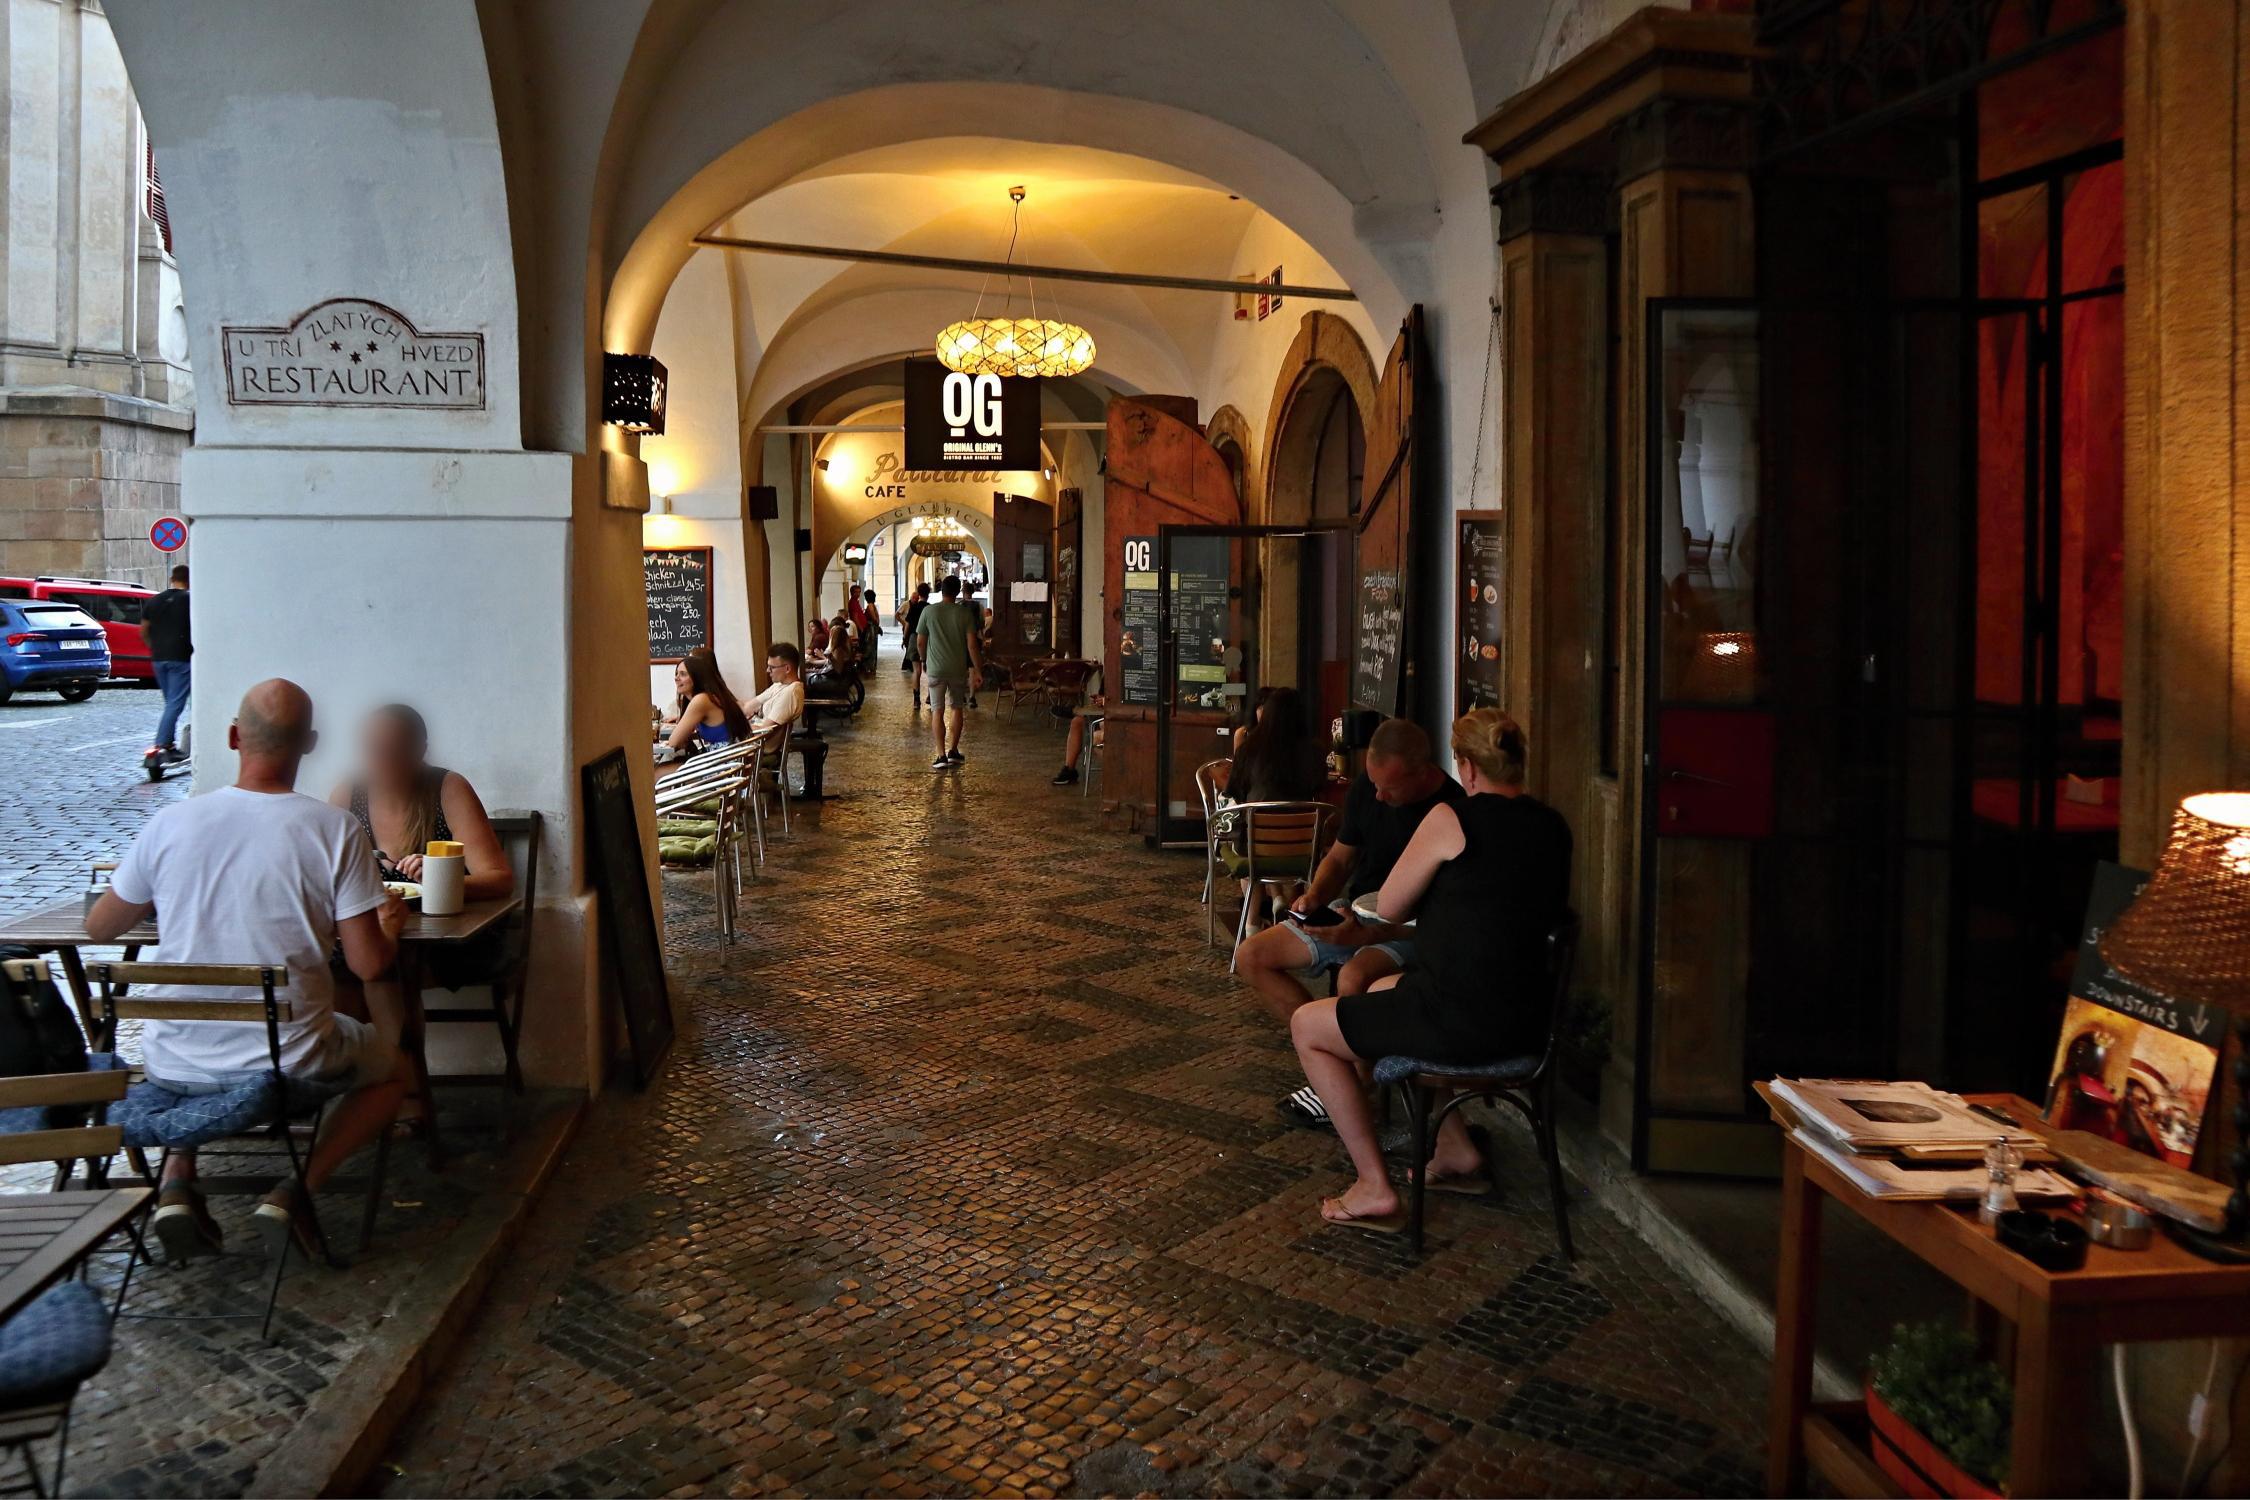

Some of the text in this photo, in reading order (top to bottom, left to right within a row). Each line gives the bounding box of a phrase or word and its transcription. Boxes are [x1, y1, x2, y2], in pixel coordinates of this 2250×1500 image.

[239, 339, 254, 357] U
[241, 366, 473, 397] RESTAURANT
[942, 371, 1003, 437] OG
[943, 442, 974, 453] ORIGINAL
[865, 485, 906, 498] CAFE
[1125, 540, 1150, 572] OG
